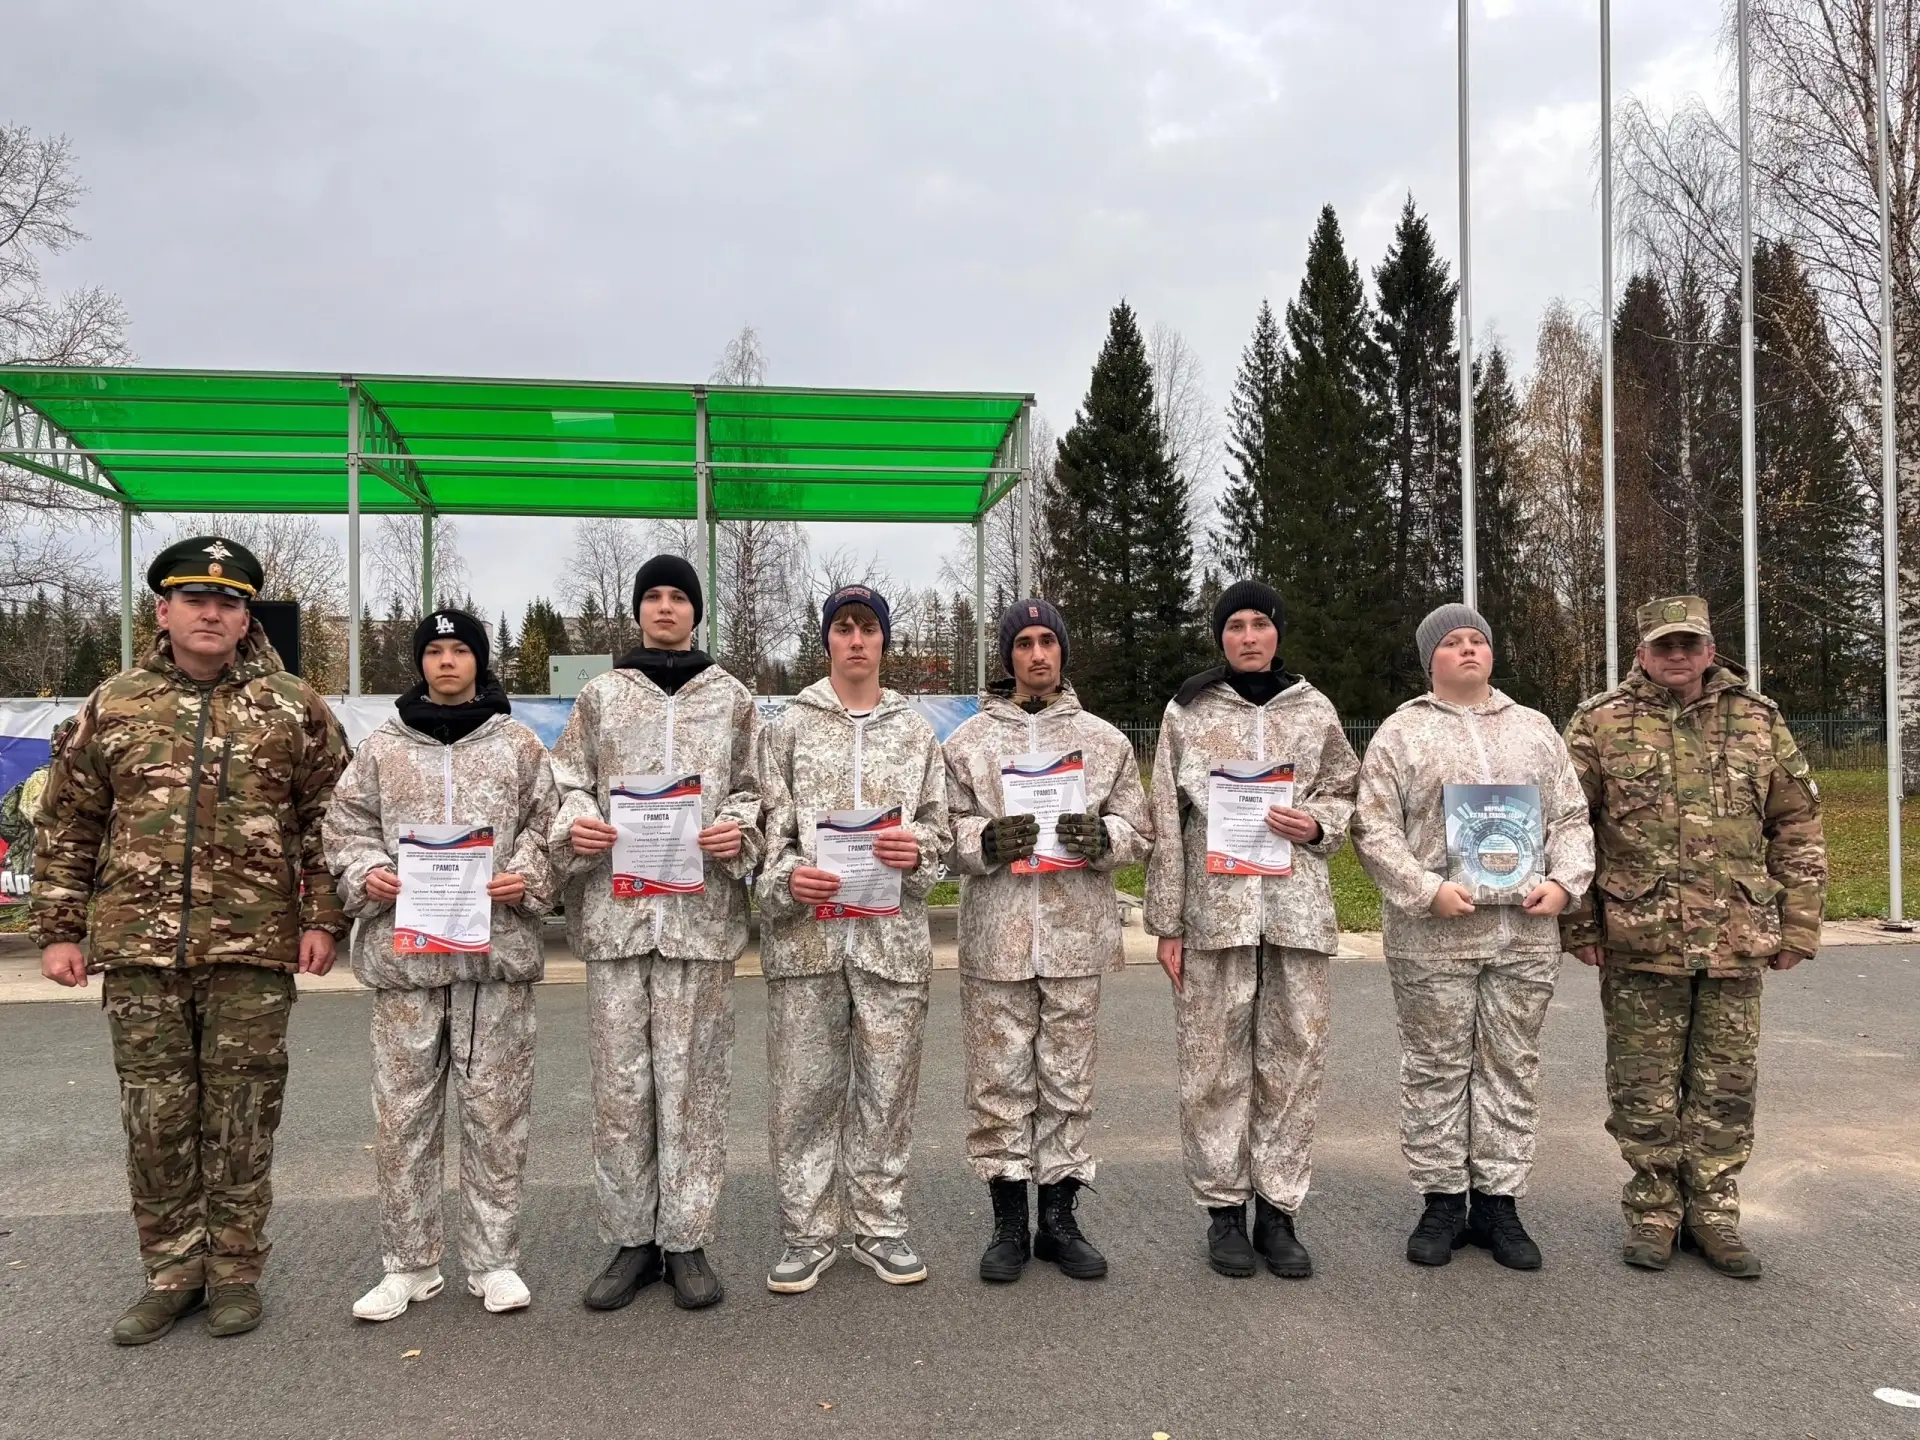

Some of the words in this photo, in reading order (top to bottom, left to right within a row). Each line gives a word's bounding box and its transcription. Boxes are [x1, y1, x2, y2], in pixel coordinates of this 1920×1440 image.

[435, 614, 454, 634] LA
[1033, 788, 1058, 797] ГРАМОТА
[1238, 795, 1263, 803] ГРАМОТА
[643, 813, 669, 821] ГРАМОТА
[848, 844, 873, 852] ГРАМОТА
[432, 864, 459, 872] ГРАМОТА
[0, 870, 34, 895] Ар
